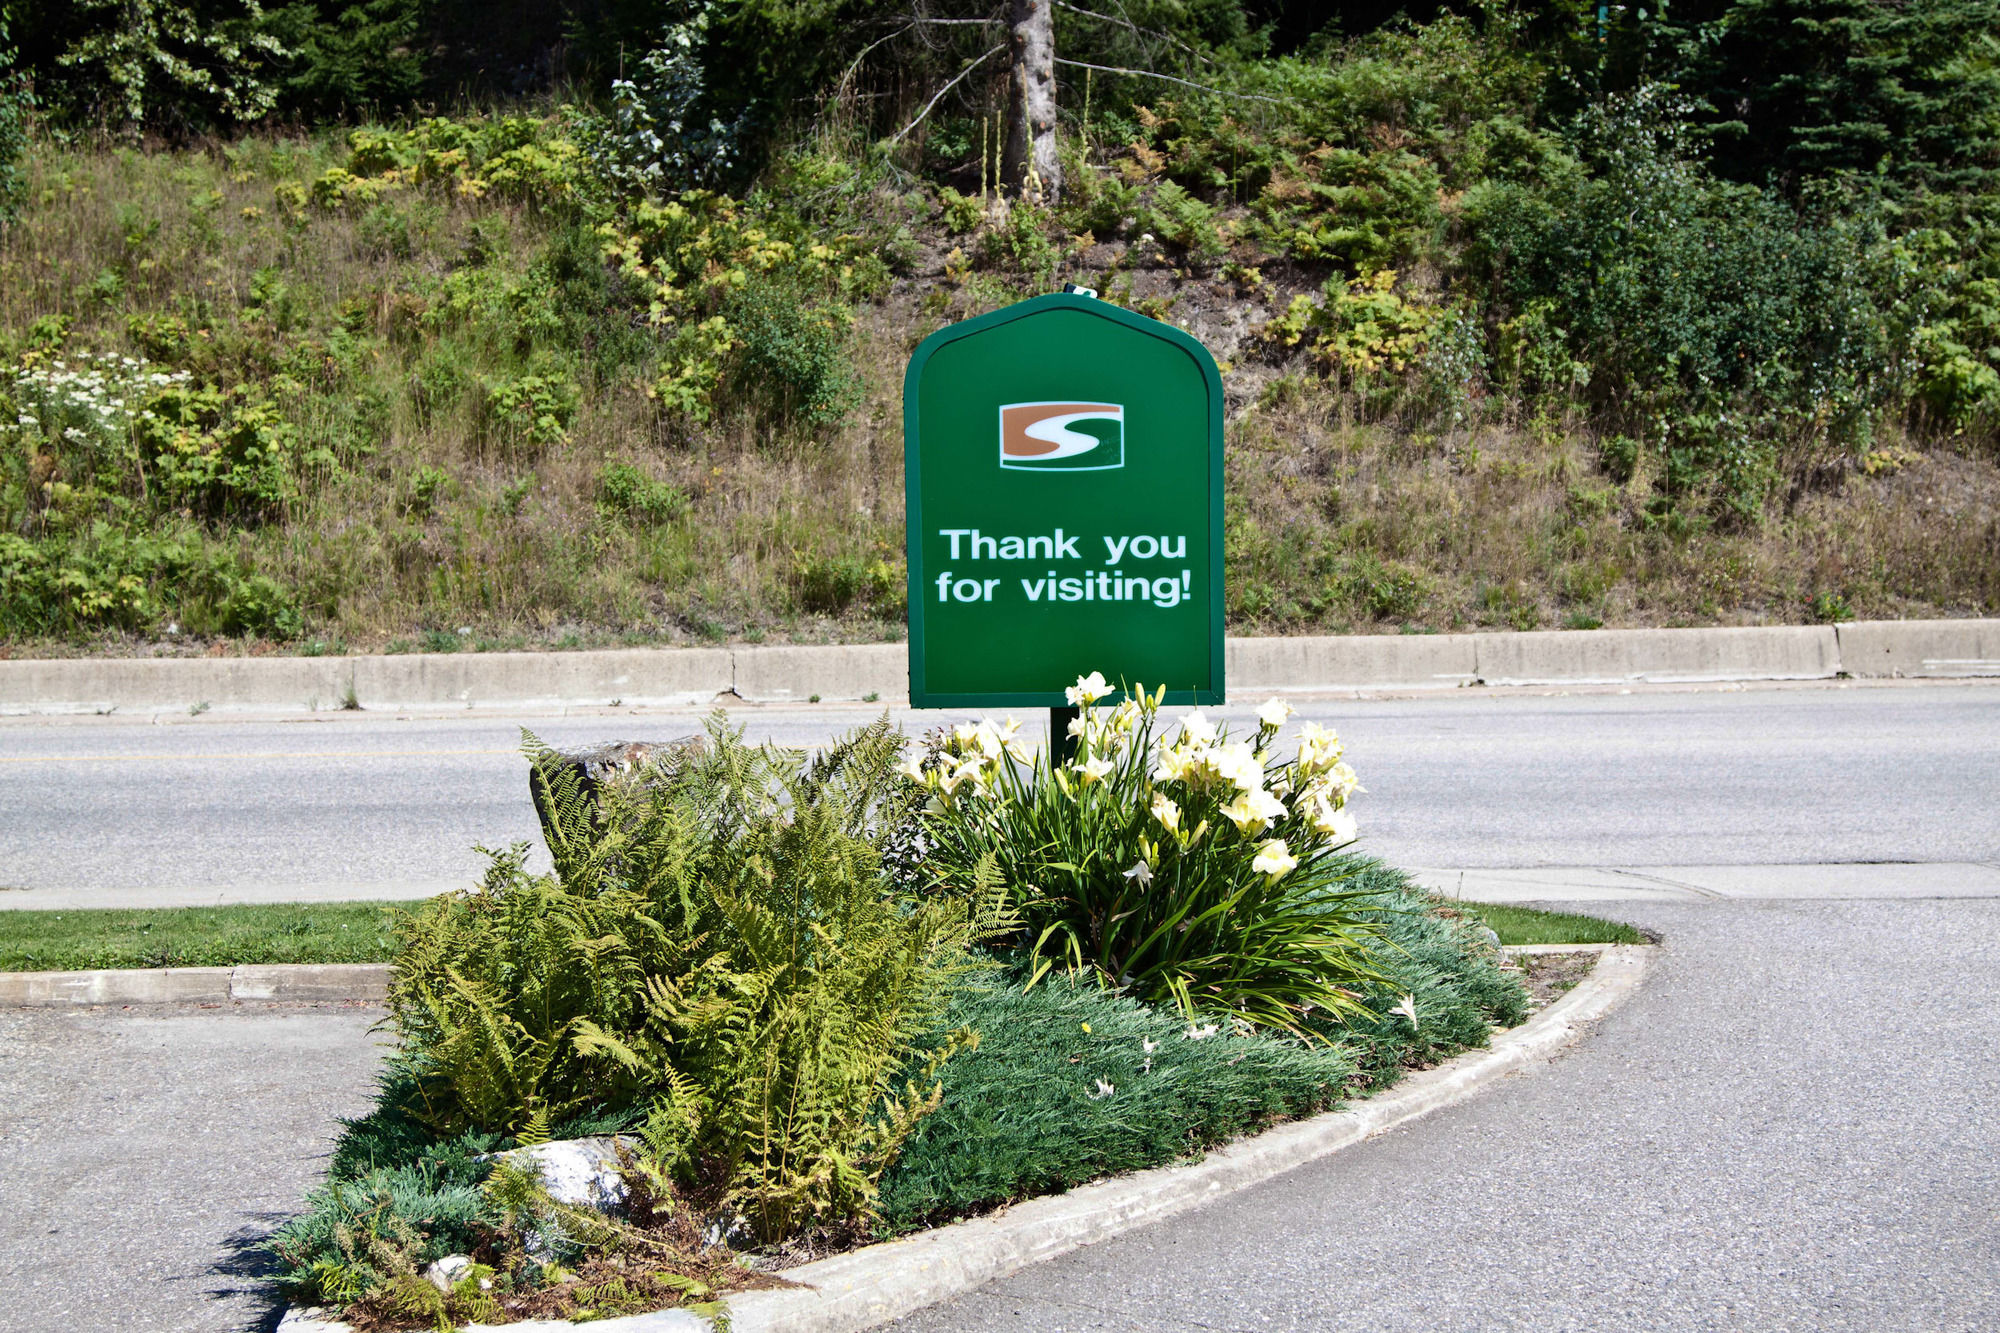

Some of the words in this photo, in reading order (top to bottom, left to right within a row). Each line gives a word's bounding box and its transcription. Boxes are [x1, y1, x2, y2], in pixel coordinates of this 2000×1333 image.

[939, 529, 1081, 560] Thank
[1104, 536, 1186, 565] you
[935, 571, 1001, 602] for
[1021, 570, 1191, 608] visiting!
